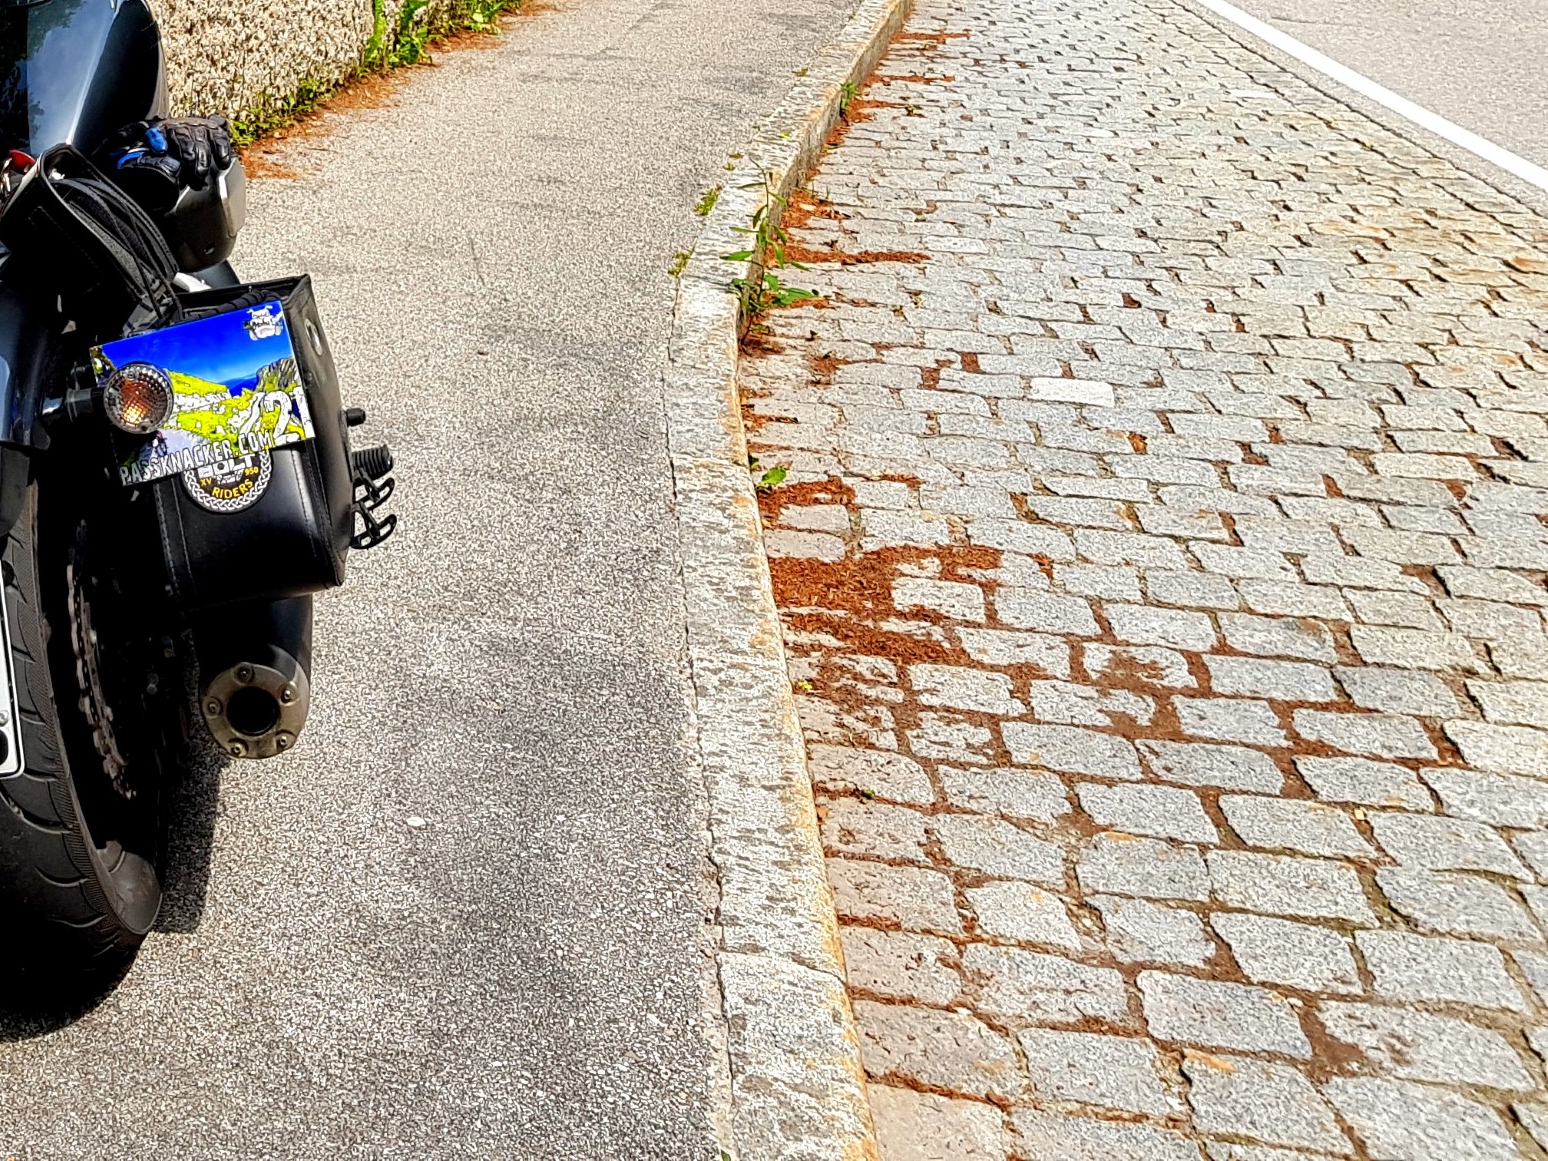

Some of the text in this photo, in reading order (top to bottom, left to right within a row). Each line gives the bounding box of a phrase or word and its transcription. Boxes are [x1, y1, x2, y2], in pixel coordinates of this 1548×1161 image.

[119, 430, 273, 487] PASSKNACKER.COM
[244, 465, 260, 477] 950
[210, 478, 255, 500] RIDERS
